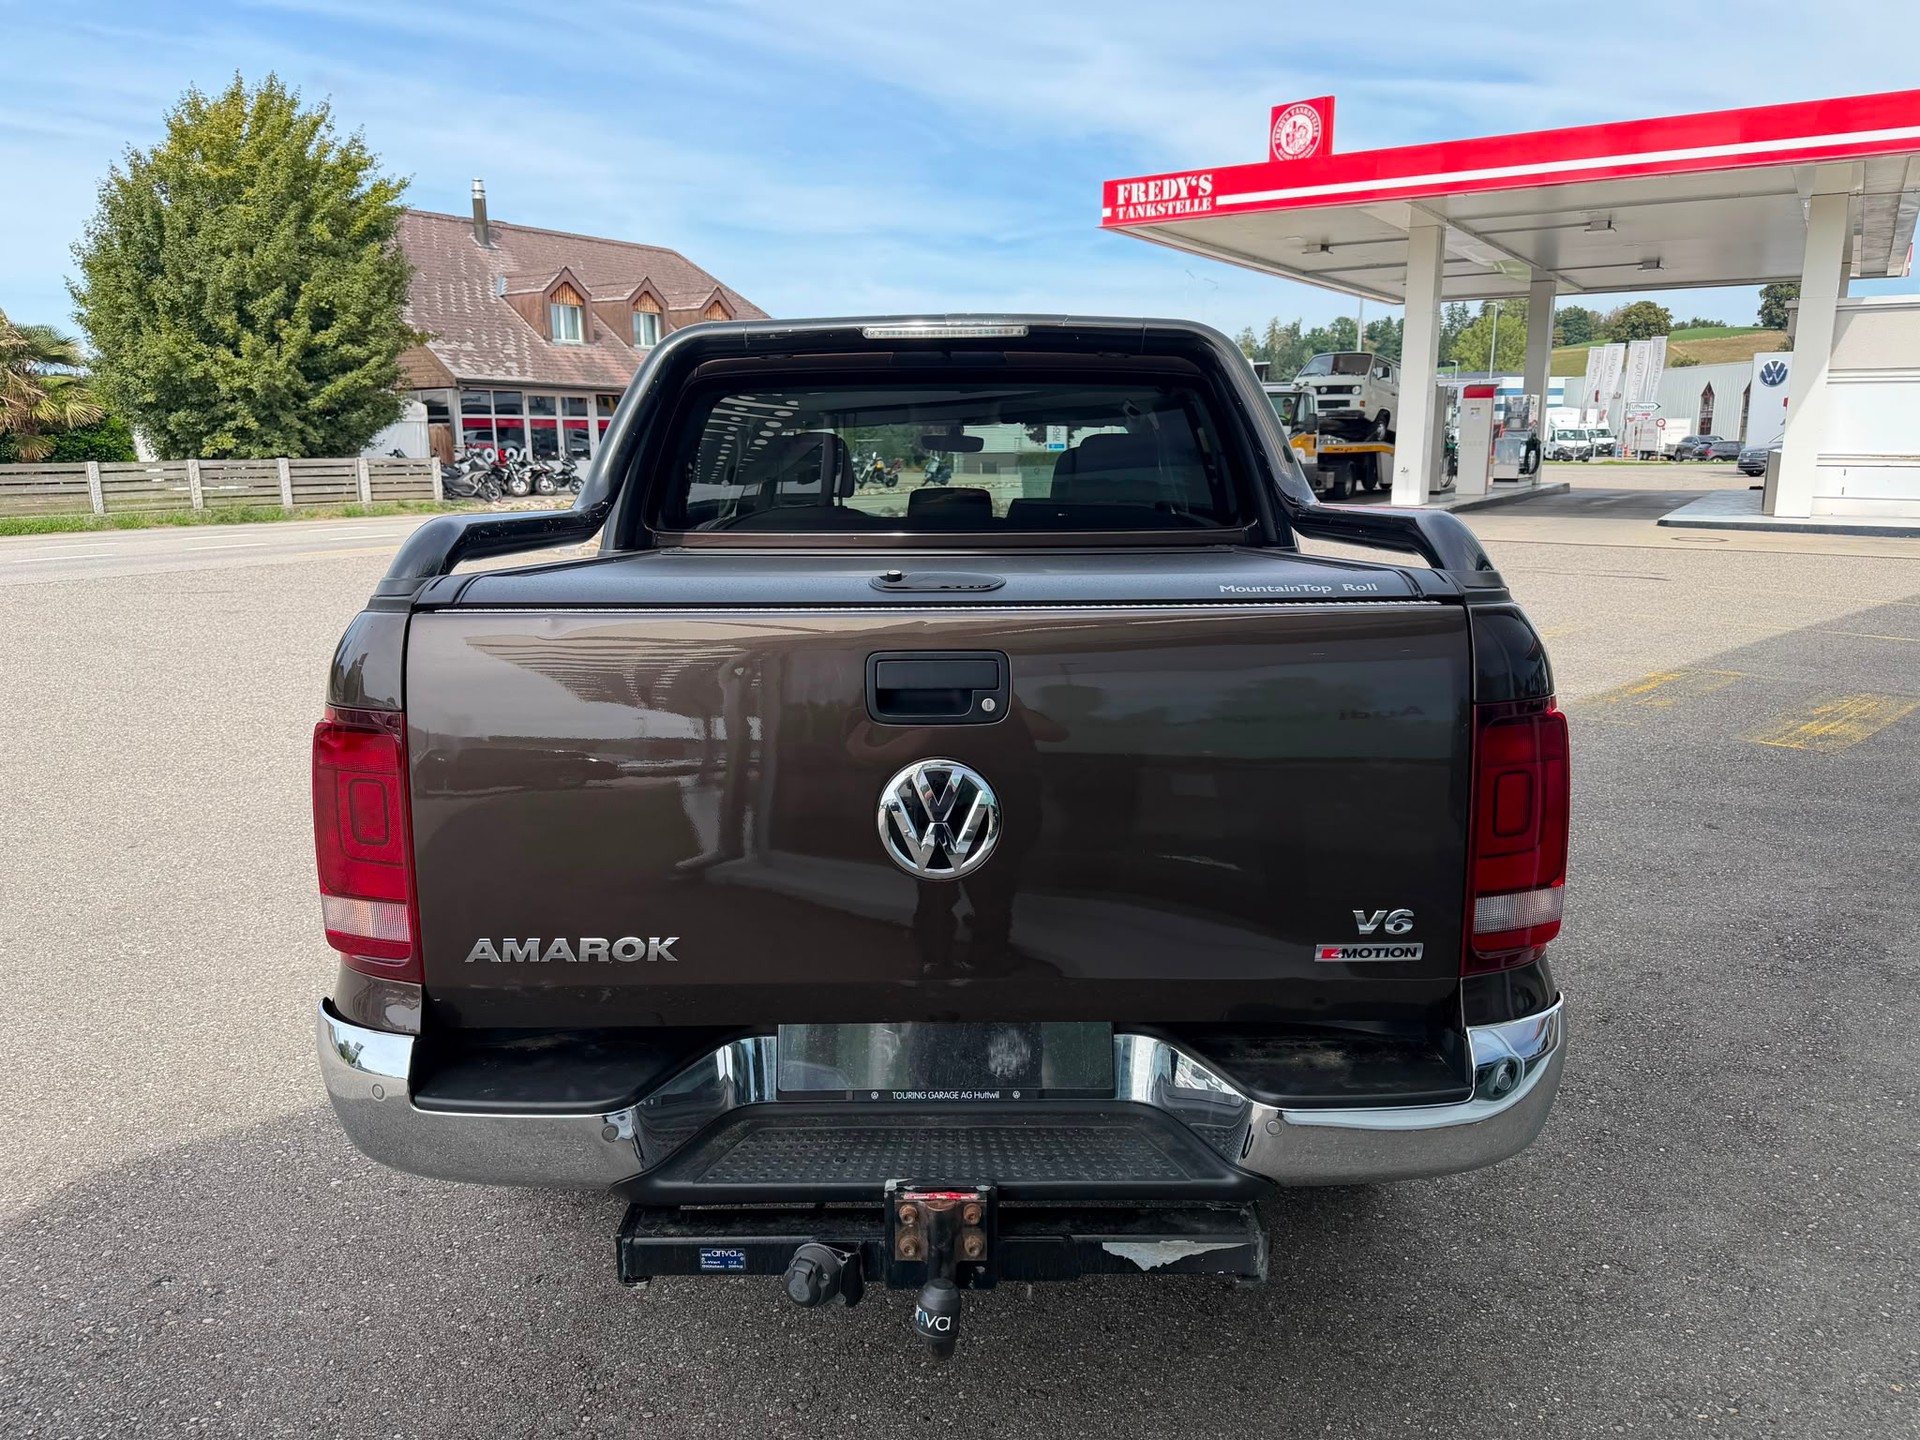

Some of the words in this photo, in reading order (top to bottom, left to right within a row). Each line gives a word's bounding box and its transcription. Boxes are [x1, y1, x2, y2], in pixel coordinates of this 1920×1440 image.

[1117, 174, 1212, 205] FREDY'S
[1116, 197, 1212, 219] TANKSTELLE
[1219, 584, 1332, 594] MountainTop
[1342, 583, 1378, 592] Roll
[1352, 908, 1415, 935] V6
[464, 936, 680, 963] AMAROK
[1321, 946, 1418, 960] 4MOTION
[892, 1091, 926, 1100] TOURING
[928, 1090, 959, 1099] GARAGE
[961, 1090, 972, 1099] AG
[974, 1090, 1000, 1099] Huttwil
